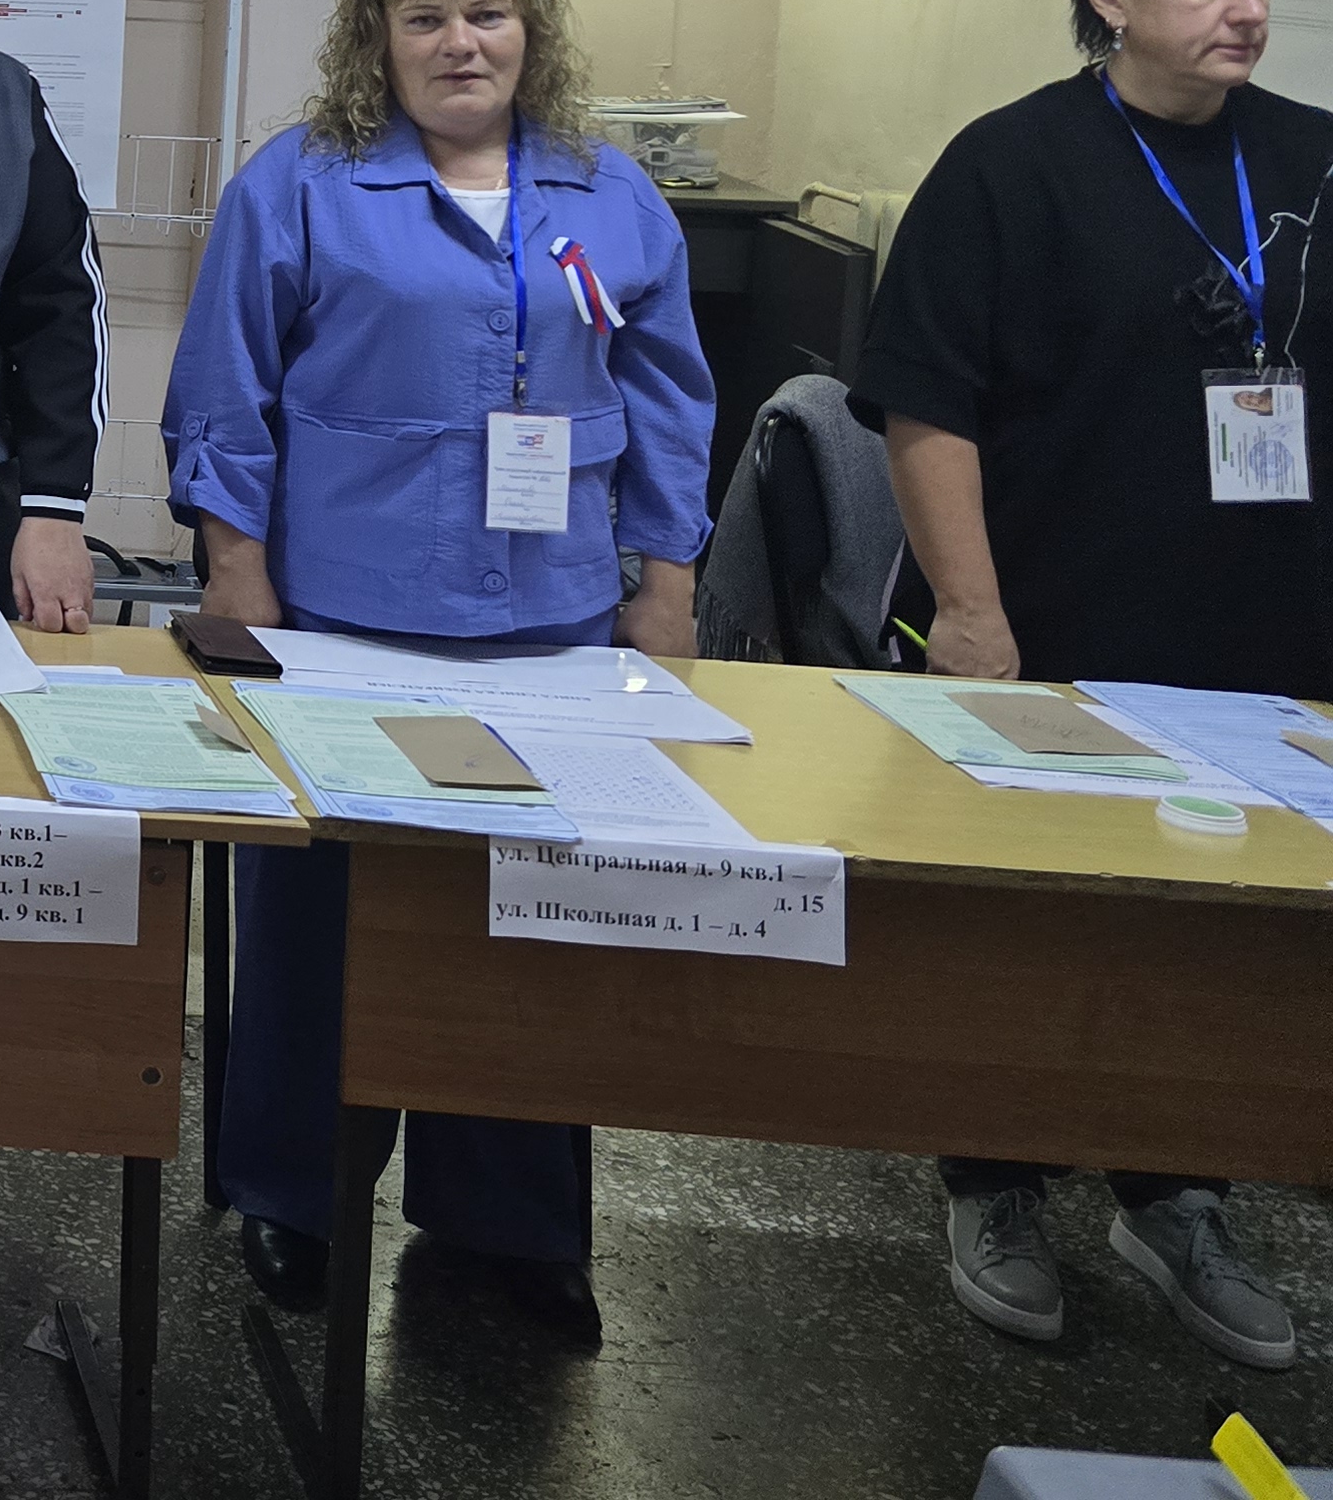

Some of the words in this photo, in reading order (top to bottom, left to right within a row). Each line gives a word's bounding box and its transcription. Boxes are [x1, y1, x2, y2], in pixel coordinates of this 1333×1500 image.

[0, 851, 43, 869] кв.2
[496, 845, 529, 866] ул.
[537, 845, 687, 874] Центральная
[693, 861, 713, 877] д.
[720, 859, 732, 877] 9
[740, 863, 784, 883] кв.1
[21, 877, 29, 894] 1
[38, 880, 81, 898] кв.1
[16, 903, 28, 921] 9
[35, 908, 67, 923] кв.
[75, 907, 83, 924] 1
[773, 896, 792, 913] д.
[801, 895, 825, 913] 15
[496, 902, 528, 921] ул.
[535, 900, 657, 929] Школьная
[663, 916, 683, 932] д.
[691, 913, 700, 932] 1
[727, 921, 747, 937] д.
[754, 919, 766, 938] 4
